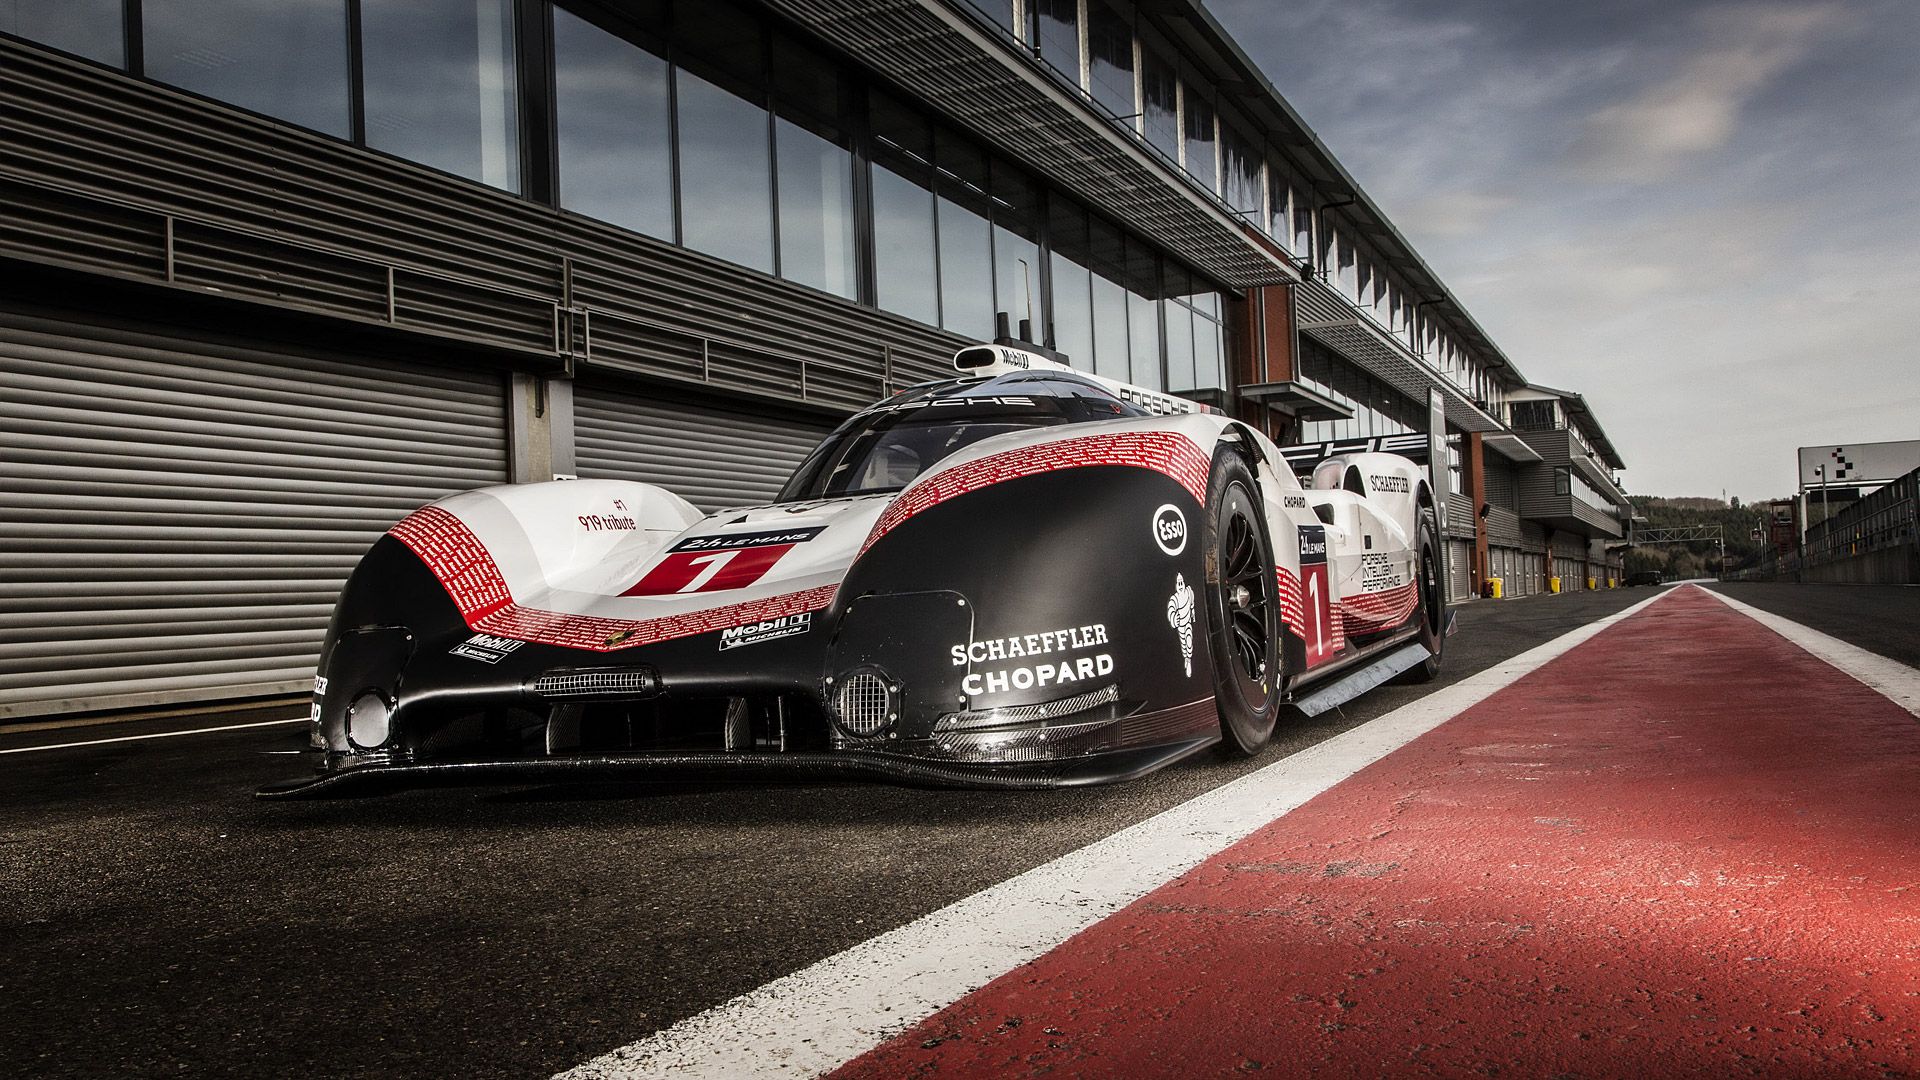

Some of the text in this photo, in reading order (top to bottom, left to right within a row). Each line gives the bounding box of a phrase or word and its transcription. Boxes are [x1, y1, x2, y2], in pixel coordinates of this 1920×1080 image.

[1000, 349, 1022, 368] Mobil
[1120, 388, 1189, 415] PORSCHE
[1370, 475, 1410, 494] SCHAEFFLER
[1283, 496, 1306, 508] CHOPARD
[578, 514, 636, 531] 919 tribute
[1158, 519, 1184, 541] Esso
[1362, 553, 1388, 566] PORSCHE
[675, 550, 742, 594] 1
[1362, 564, 1394, 578] INTELLIGENT
[1361, 575, 1401, 592] PERFORMANCE
[1309, 571, 1323, 656] 1
[722, 617, 787, 639] Mobil
[744, 626, 802, 642] MICHELIN
[465, 633, 512, 650] Mobil
[950, 623, 1109, 666] SCHAEFFLER
[961, 653, 1114, 696] CHOPARD
